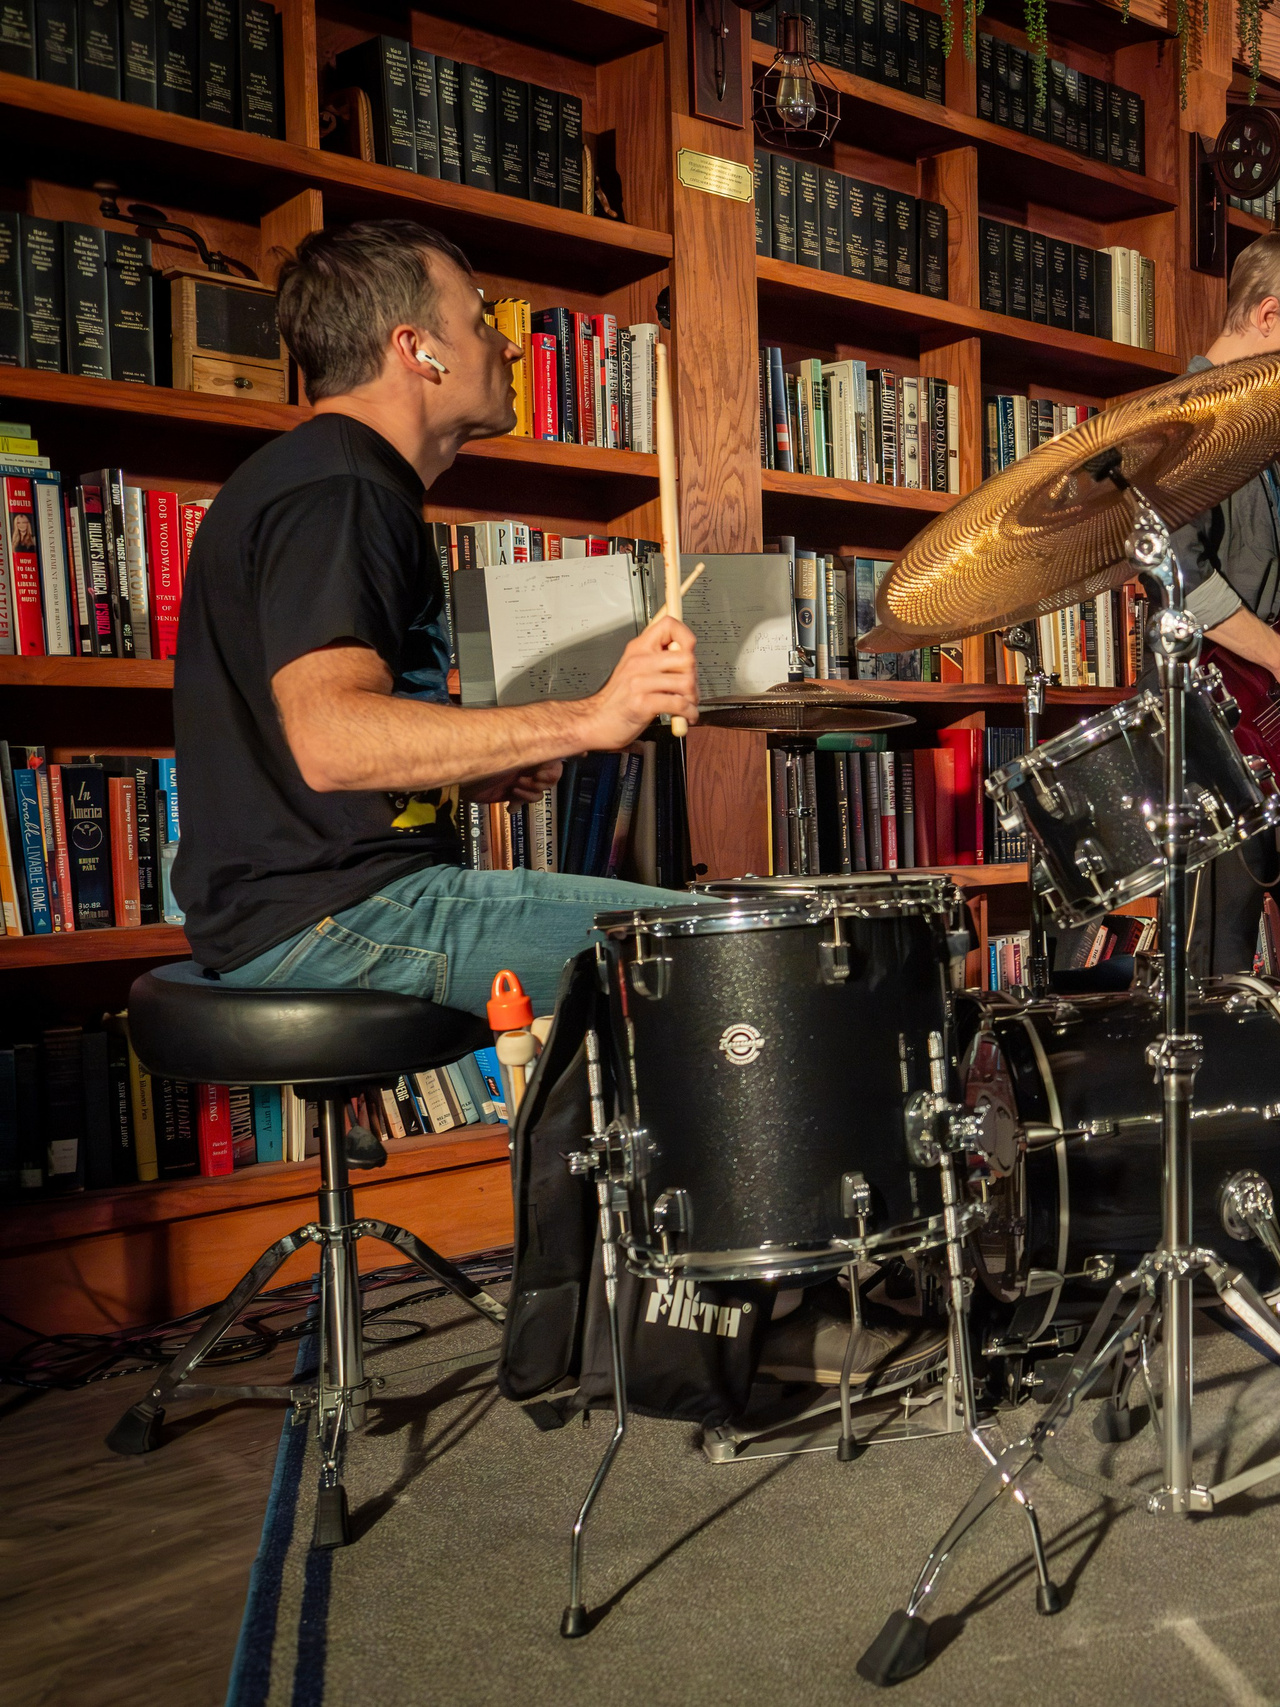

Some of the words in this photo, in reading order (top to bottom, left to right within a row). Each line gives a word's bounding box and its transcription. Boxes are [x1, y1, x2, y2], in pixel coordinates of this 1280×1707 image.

[608, 318, 617, 356] DENNIS
[620, 332, 630, 396] BLACKLASH
[608, 361, 618, 402] PRAGER
[882, 389, 895, 426] ROBERT
[935, 397, 946, 426] ROAD
[936, 429, 944, 440] TO
[883, 441, 896, 460] LEE
[936, 442, 946, 489] DISUNION
[112, 483, 120, 505] DOWD
[158, 498, 167, 519] BOB
[184, 508, 194, 522] My
[185, 522, 194, 537] Life
[88, 522, 104, 560] HILLARY'S
[159, 523, 171, 588] WOODWARD
[92, 561, 108, 596] AMERICA
[826, 571, 834, 592] WILD
[156, 594, 176, 602] STATE
[94, 602, 110, 635] D'SOUZA
[50, 774, 60, 794] The
[78, 782, 91, 801] In
[136, 768, 148, 810] America
[20, 788, 36, 846] lovable
[54, 797, 64, 845] Emotional
[69, 794, 103, 820] America
[138, 814, 149, 822] Is
[140, 826, 150, 842] Me
[27, 846, 44, 884] LIVABLE
[58, 848, 67, 879] House
[32, 886, 46, 912] HOME
[229, 1093, 253, 1144] FRANZEN
